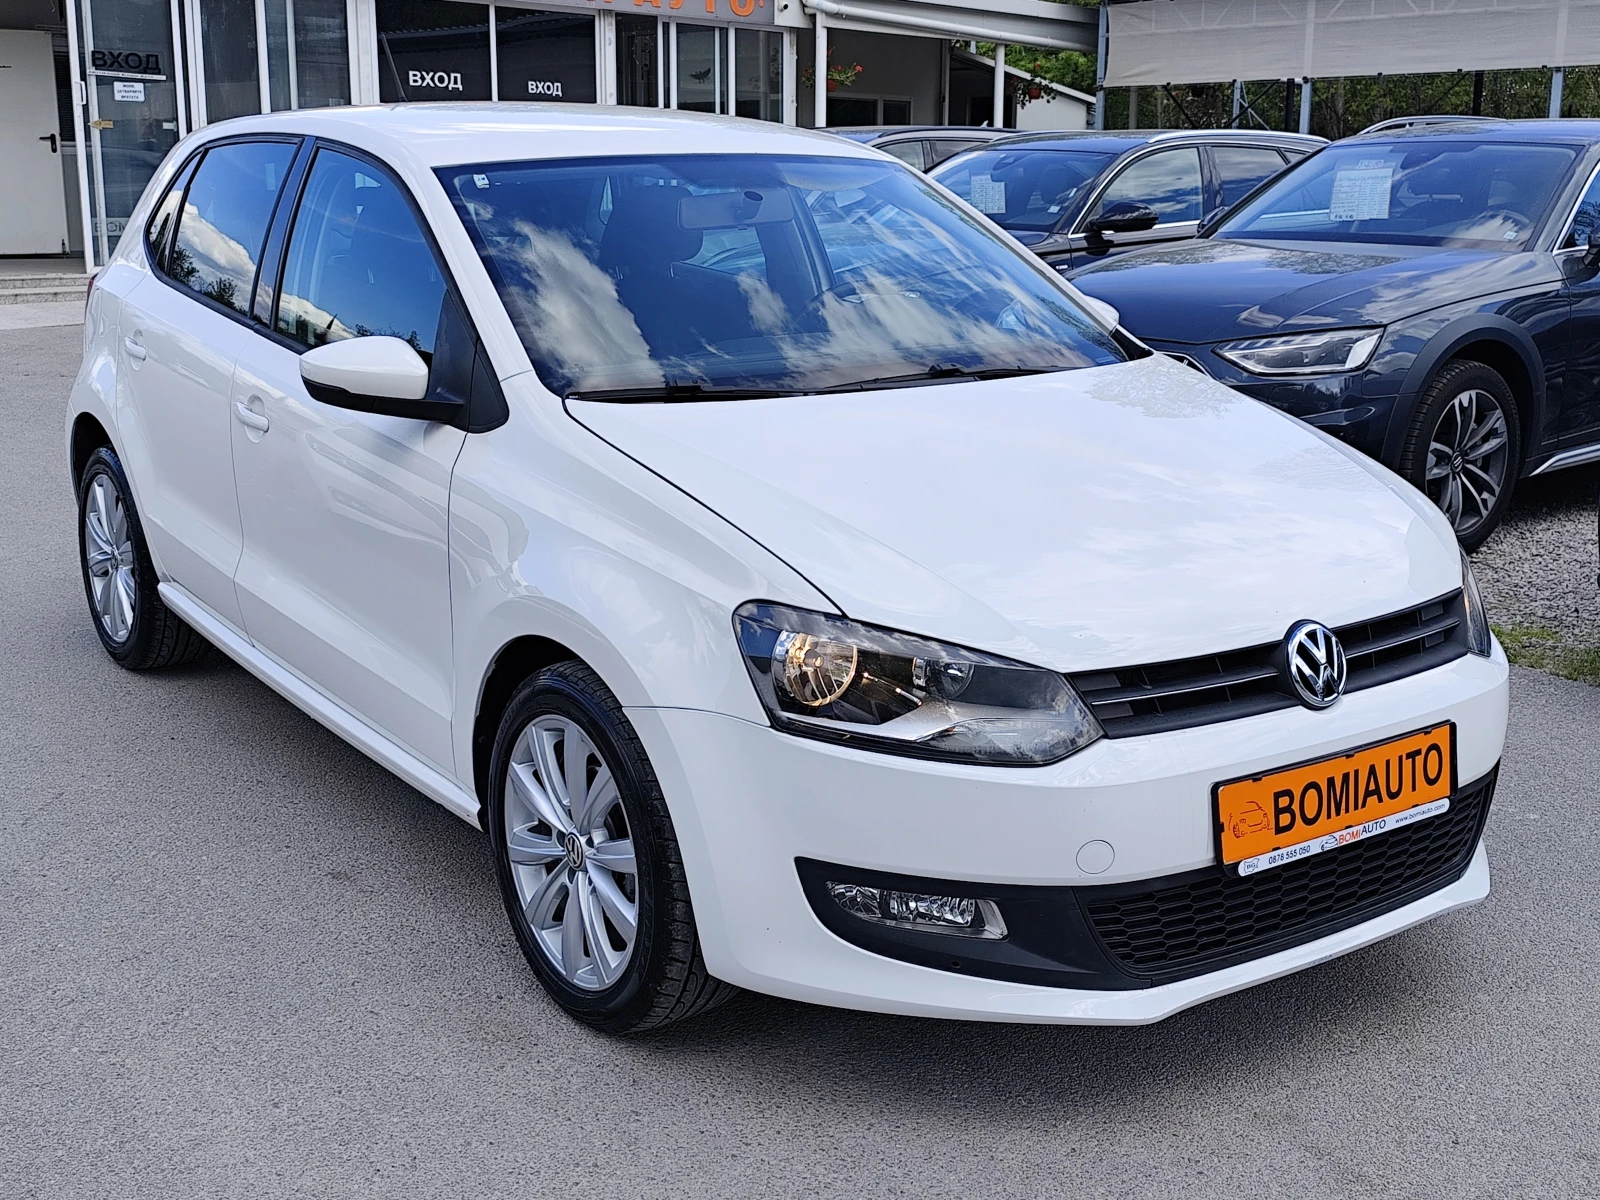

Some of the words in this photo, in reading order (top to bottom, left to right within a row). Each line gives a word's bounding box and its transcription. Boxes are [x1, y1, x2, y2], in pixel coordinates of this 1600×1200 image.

[91, 50, 161, 75] ВХОД
[408, 70, 463, 92] ВХОД
[527, 80, 563, 98] ВХОД
[1273, 742, 1444, 836] BOMIAUTO
[1395, 803, 1446, 824] www.bomiauto.com
[1268, 852, 1285, 865] 0878
[1285, 848, 1298, 860] 555
[1298, 844, 1311, 855] 050
